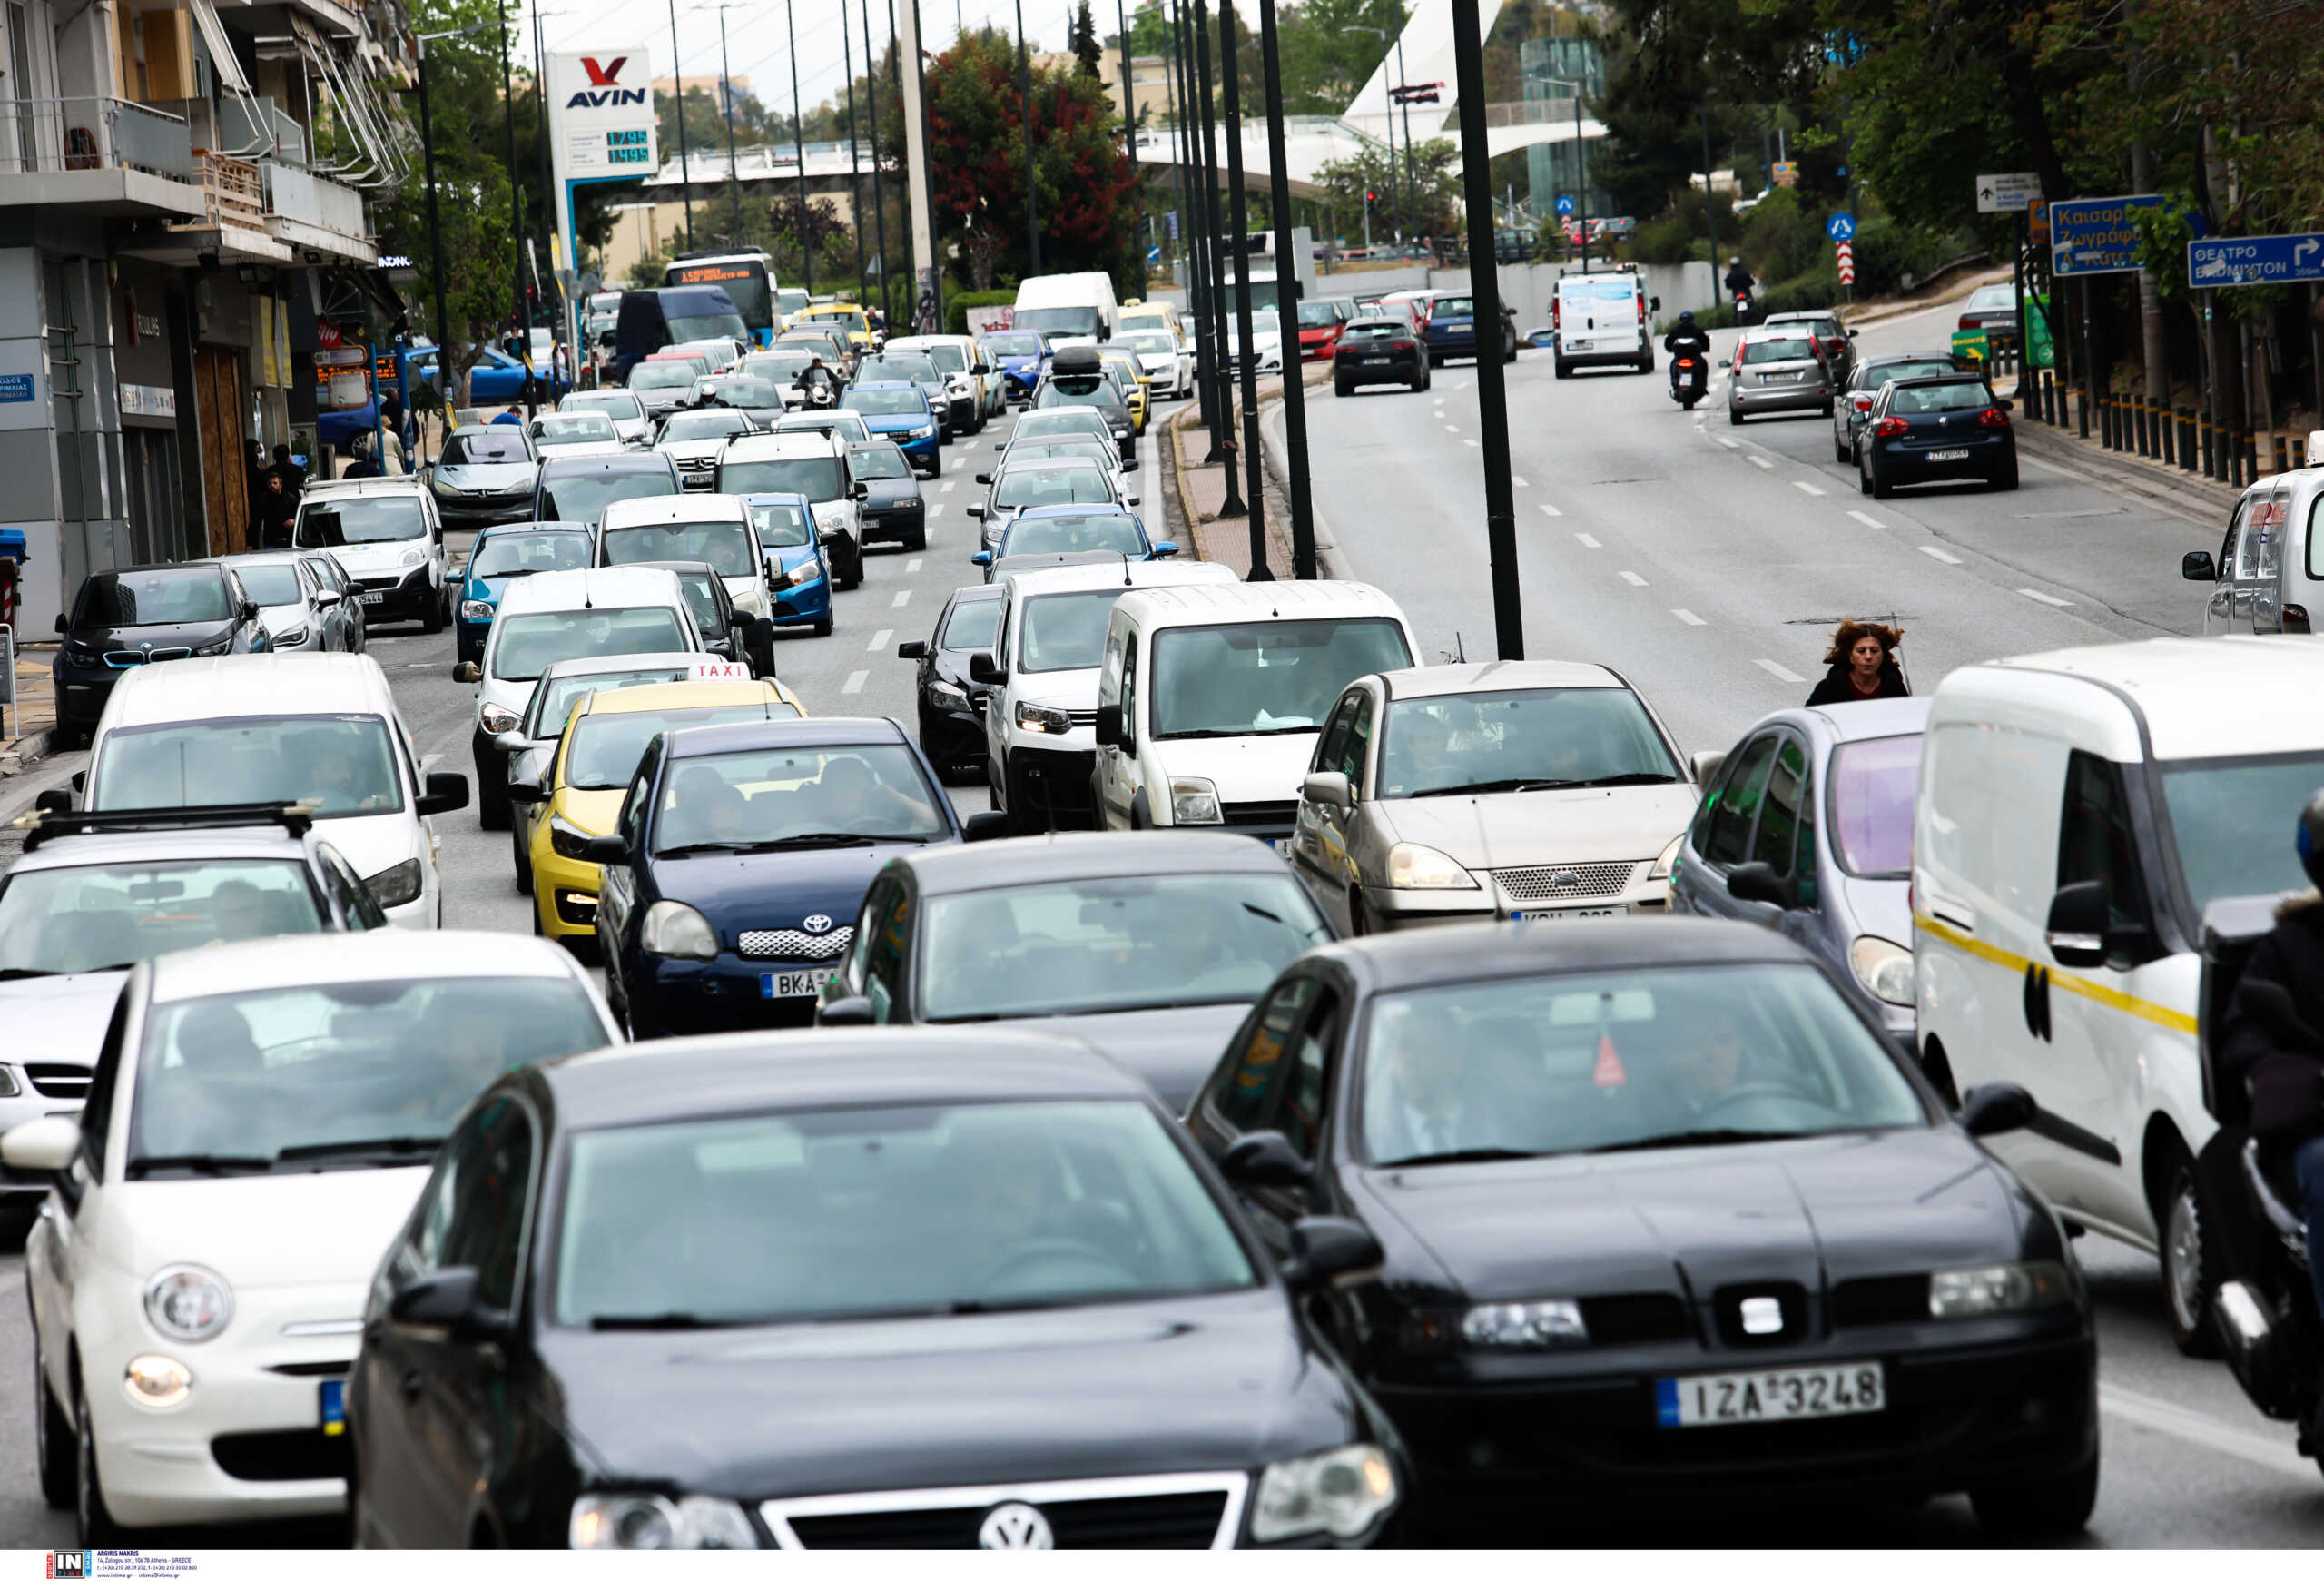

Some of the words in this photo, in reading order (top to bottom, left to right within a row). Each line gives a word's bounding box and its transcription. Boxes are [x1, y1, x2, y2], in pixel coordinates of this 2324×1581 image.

[566, 88, 645, 109] AVIN
[2058, 209, 2123, 227] Καισαρ
[2195, 246, 2257, 262] ΘΕΑΤΡΟ
[697, 664, 742, 677] TAXI
